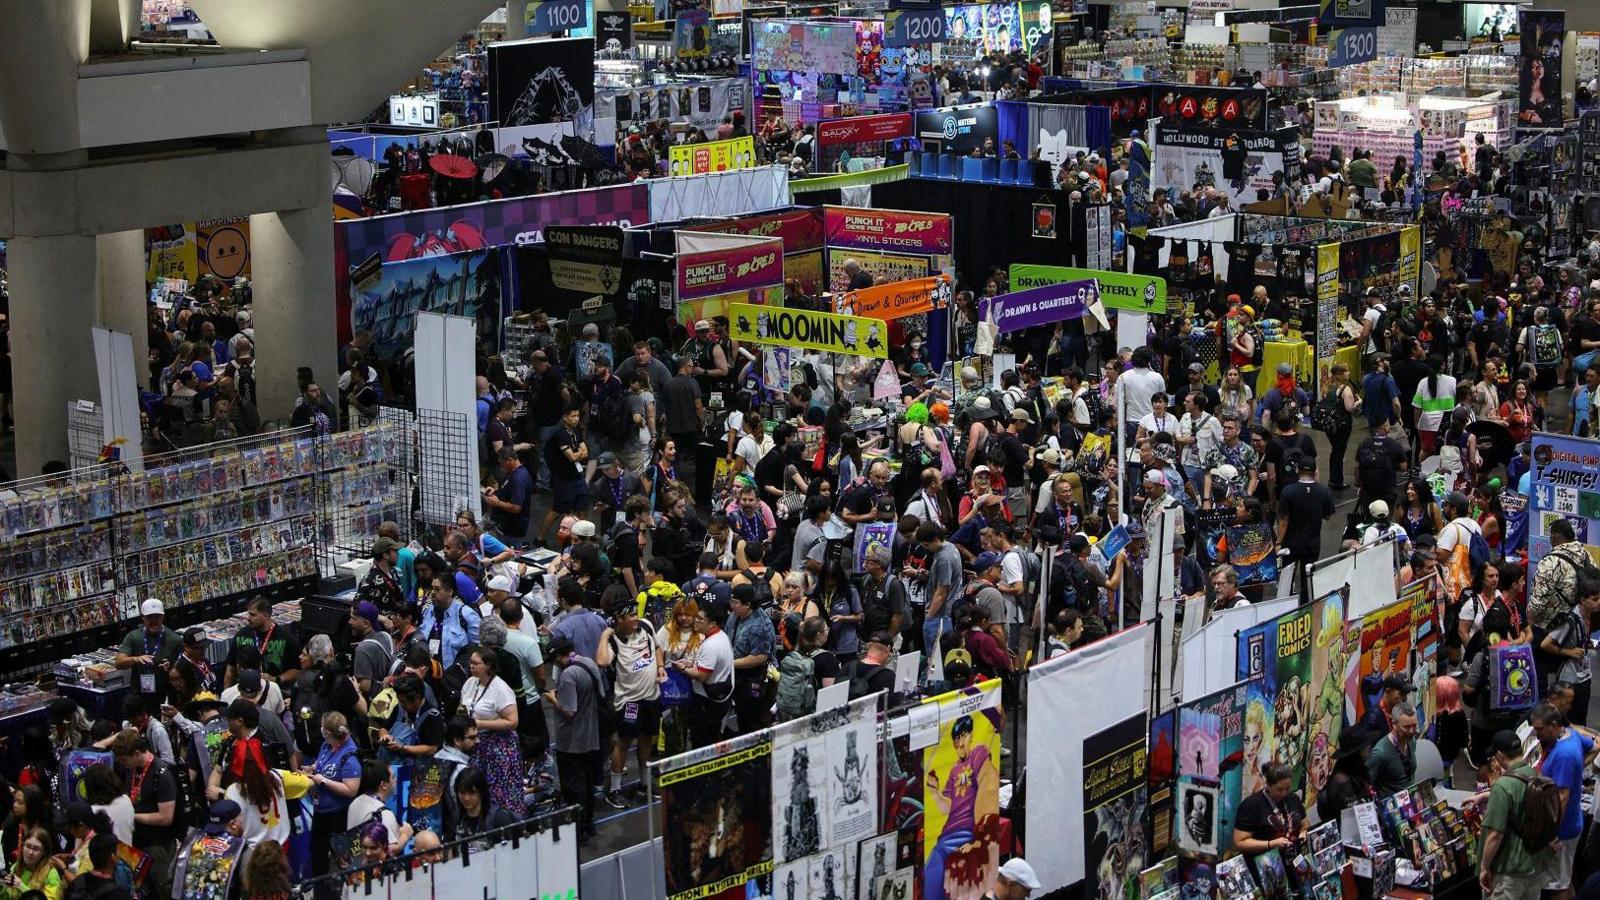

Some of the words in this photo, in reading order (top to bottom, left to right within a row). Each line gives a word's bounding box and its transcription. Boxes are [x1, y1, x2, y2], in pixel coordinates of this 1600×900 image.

[547, 4, 580, 27] 1100
[904, 16, 941, 40] 1200
[1343, 31, 1374, 60] 1300
[1163, 134, 1208, 145] HOLLYWOOD
[1214, 137, 1275, 149] STBOARDS
[845, 216, 873, 226] PUNCH
[875, 218, 884, 227] IT
[549, 231, 571, 244] CON
[573, 235, 619, 250] RANGERS
[857, 235, 880, 244] VINYL
[882, 237, 923, 247] STICKERS
[685, 266, 715, 278] PUNCH
[717, 263, 727, 274] IT
[685, 275, 708, 285] CHEWIE
[857, 300, 880, 312] Drawn
[883, 295, 890, 308] &
[894, 284, 930, 307] Quarterly
[1099, 284, 1138, 297] RTERLY
[1005, 303, 1032, 318] DRAWN
[1032, 303, 1038, 312] &
[1038, 295, 1077, 310] QUARTERLY
[766, 312, 847, 348] MOOMIN
[1551, 451, 1581, 464] DIGITAL
[1536, 465, 1599, 491] T-SHIRTS!
[1557, 488, 1568, 499] $25
[1278, 612, 1312, 645] FRIED
[1278, 635, 1312, 659] COMICS
[959, 694, 984, 708] SCOTT
[961, 702, 982, 715] LOST
